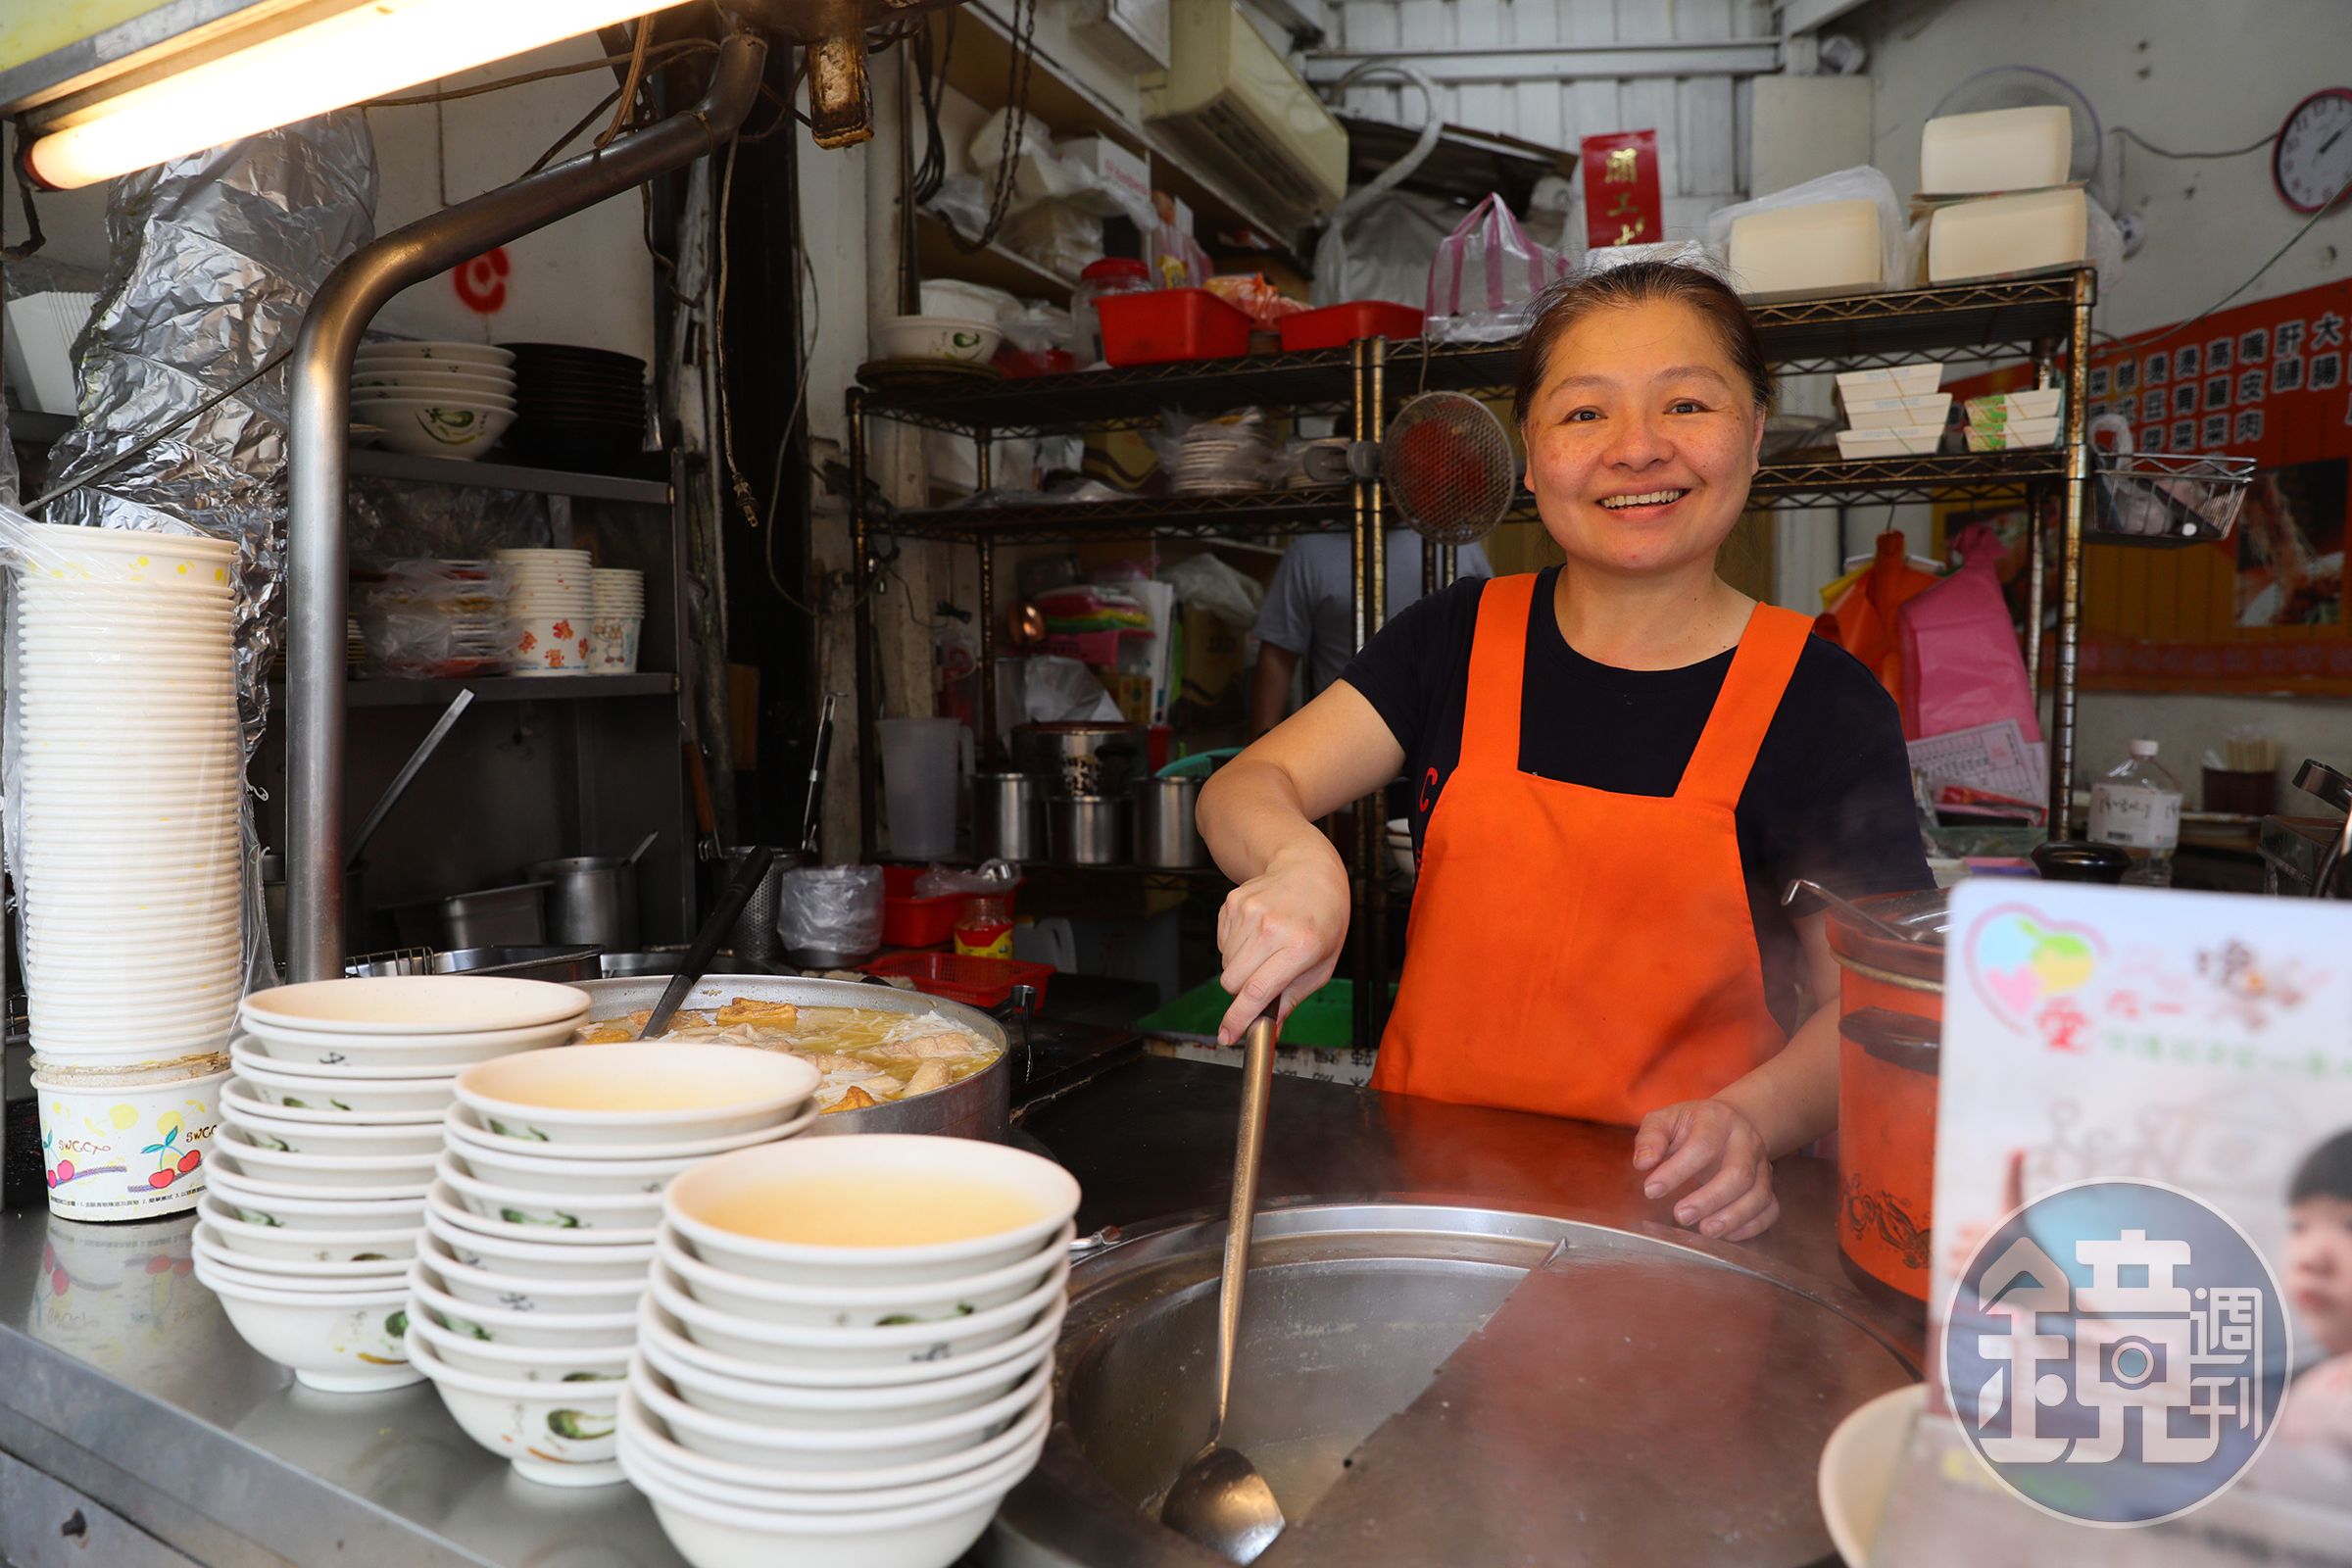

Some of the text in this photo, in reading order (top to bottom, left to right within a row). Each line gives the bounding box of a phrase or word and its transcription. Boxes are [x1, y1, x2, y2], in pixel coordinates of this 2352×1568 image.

[2201, 336, 2233, 448] 高麗菜
[2308, 311, 2343, 392] 大腸
